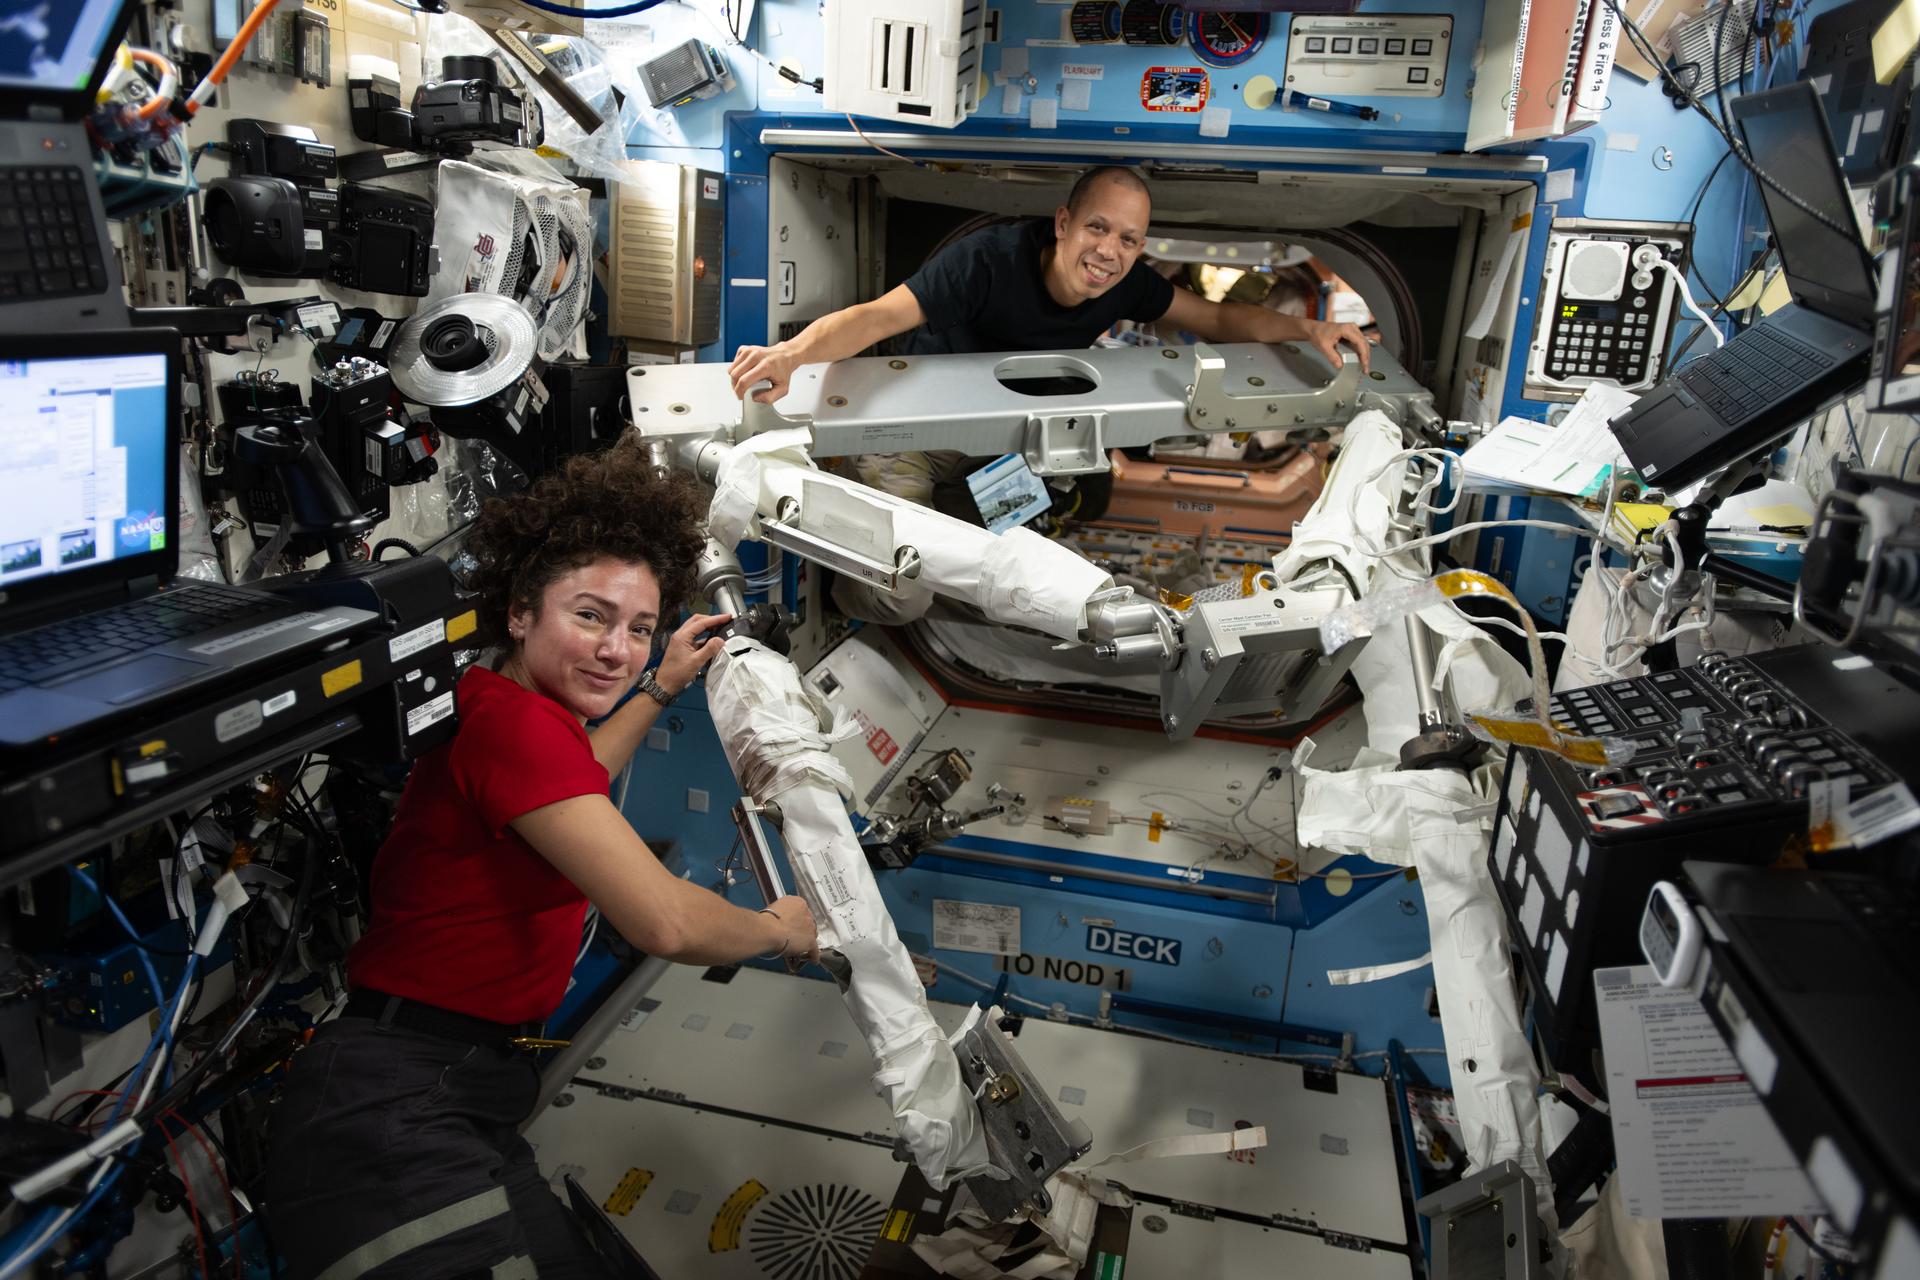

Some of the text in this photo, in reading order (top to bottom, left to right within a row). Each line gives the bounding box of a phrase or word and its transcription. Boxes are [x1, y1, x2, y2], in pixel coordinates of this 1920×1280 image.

[1594, 54, 1609, 76] Fire
[1509, 66, 1522, 121] COMPUTERS
[1592, 79, 1604, 92] 1a
[1176, 501, 1214, 512] To FGB
[120, 524, 152, 536] NASA
[1089, 928, 1178, 965] DECK
[1001, 954, 1126, 990] TO NOD 1
